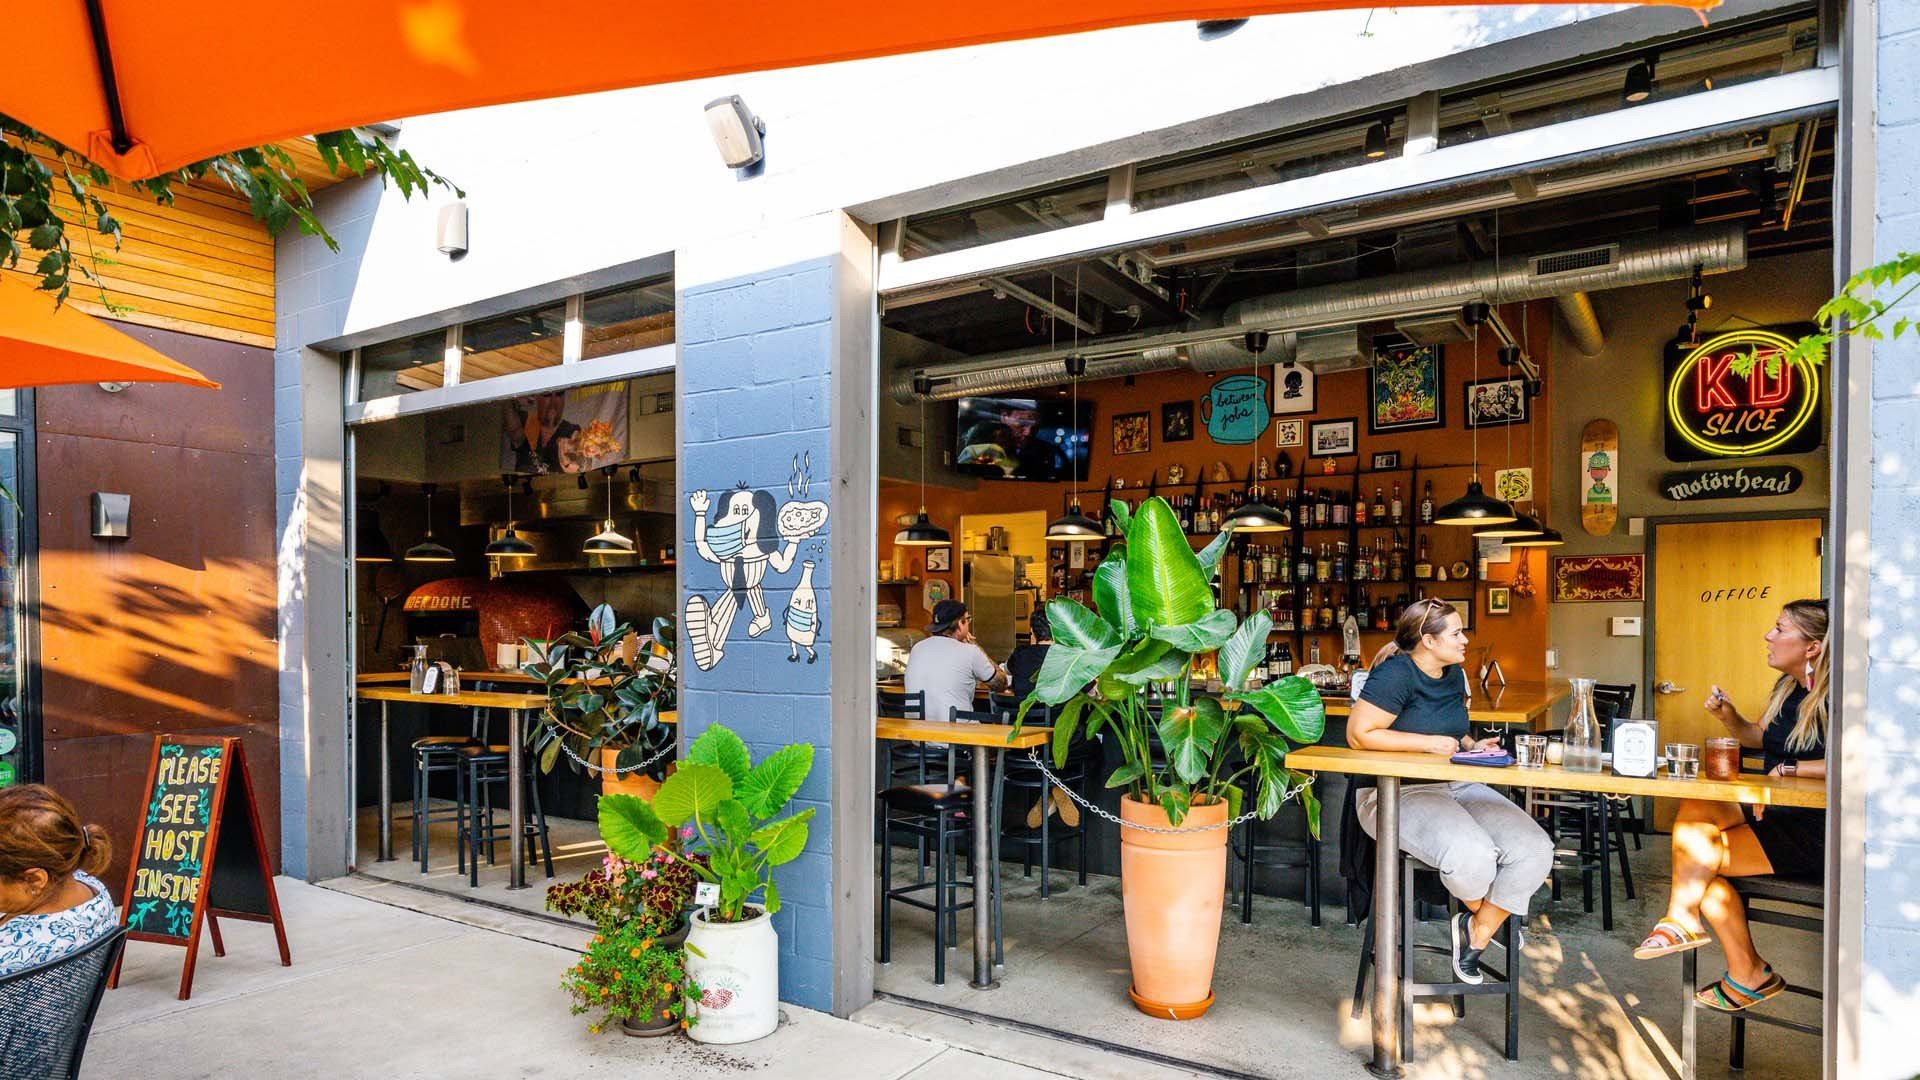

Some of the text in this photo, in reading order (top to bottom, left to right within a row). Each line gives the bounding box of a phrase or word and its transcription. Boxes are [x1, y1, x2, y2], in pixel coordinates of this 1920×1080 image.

[1216, 391, 1261, 408] between
[1221, 405, 1254, 432] jobs
[1702, 408, 1785, 436] SLICE
[430, 596, 472, 609] DOME
[1701, 586, 1772, 603] OFFICE
[158, 756, 222, 785] PLEASE
[159, 794, 199, 825] SEE
[145, 829, 205, 864] HOST
[134, 868, 201, 903] INSIDE
